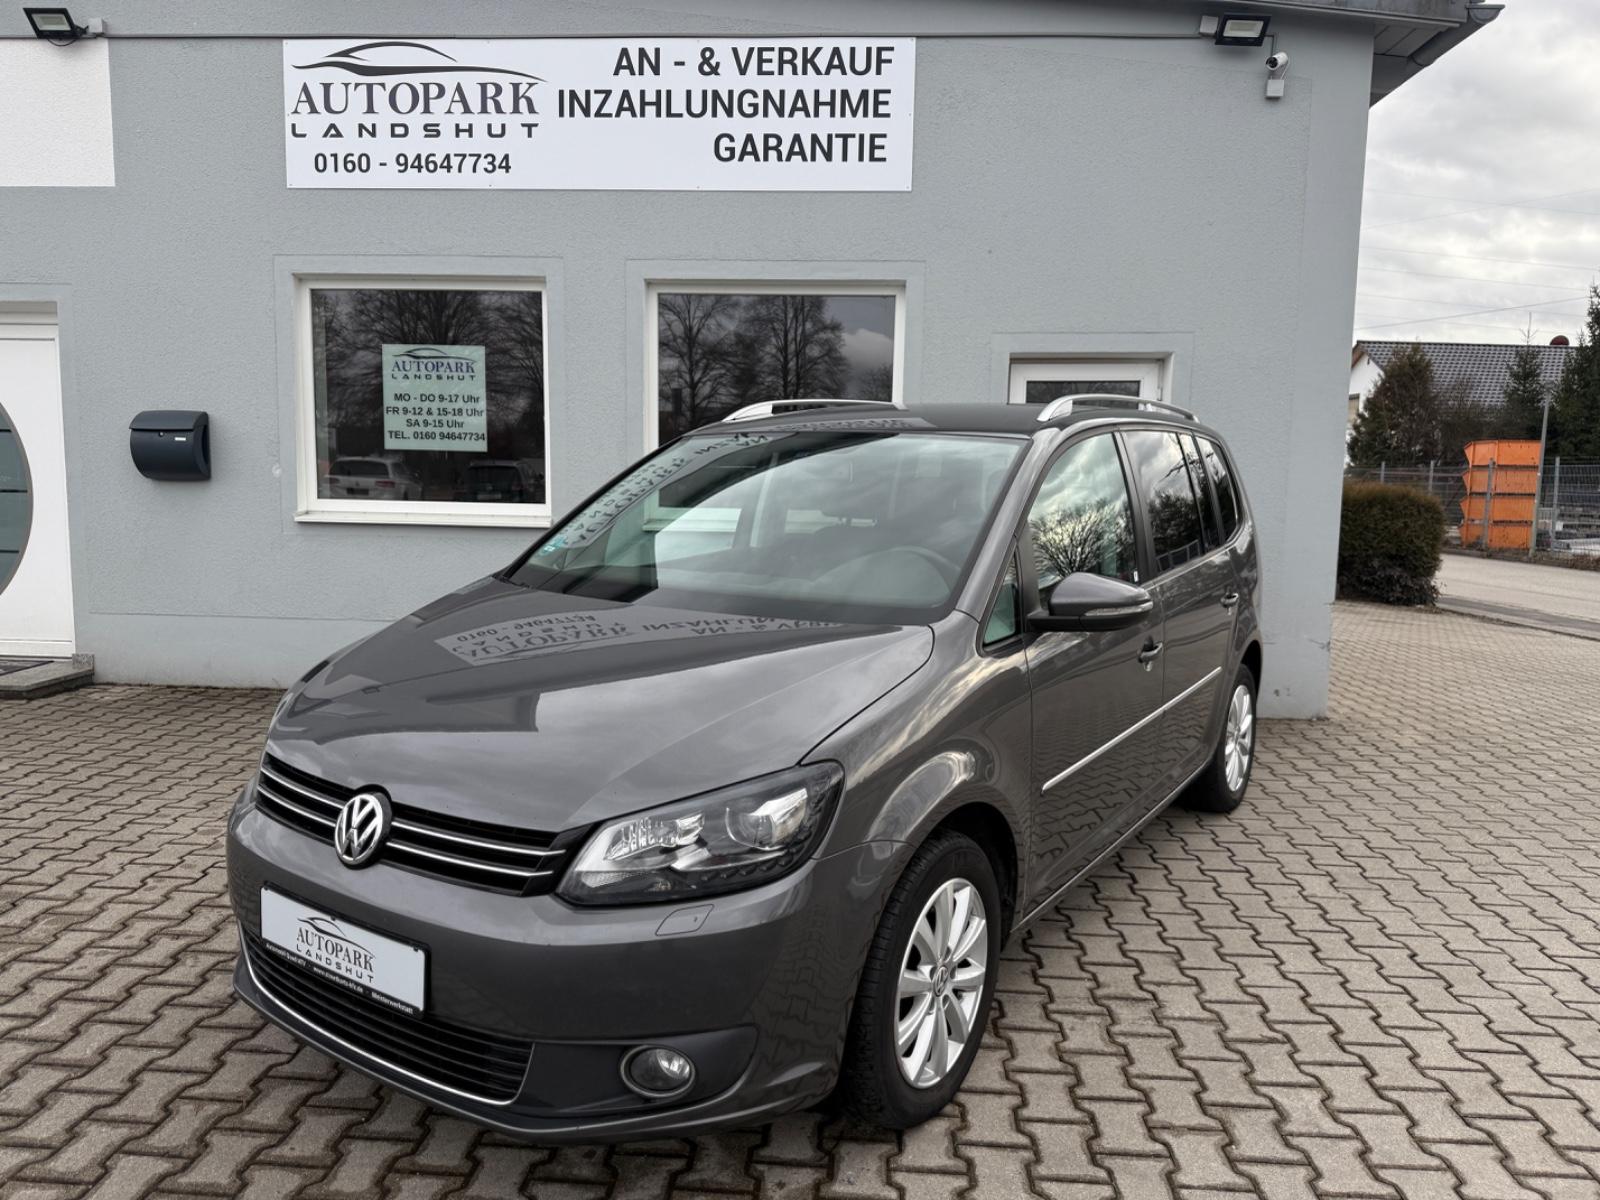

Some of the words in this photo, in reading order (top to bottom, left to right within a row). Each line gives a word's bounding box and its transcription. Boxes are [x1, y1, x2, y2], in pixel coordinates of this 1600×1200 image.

[612, 47, 661, 76] AN
[697, 46, 721, 77] &
[731, 46, 895, 76] VERKAUF
[291, 82, 539, 116] AUTOPARK
[558, 88, 892, 119] INZAHLUNGNAHME
[291, 122, 539, 139] LANDSHUT
[713, 132, 888, 163] GARANTIE
[314, 152, 371, 174] 0160
[395, 152, 512, 174] 94647734
[392, 360, 475, 374] AUTOPARK
[394, 393, 411, 402] MO
[420, 394, 436, 402] DO
[438, 394, 460, 403] 9-17
[462, 395, 481, 404] Uhr
[386, 406, 400, 415] FR
[402, 407, 424, 416] 9-12
[426, 407, 434, 416] &
[436, 408, 463, 416] 15-18
[465, 408, 484, 417] Uhr
[406, 419, 421, 428] SA
[423, 419, 444, 428] 9-15
[446, 420, 465, 429] Uhr
[388, 430, 410, 440] TEL.
[413, 431, 436, 441] 0160
[439, 432, 486, 442] 94647734
[296, 927, 374, 973] AUTOPARK
[296, 943, 375, 984] LANDSHUT
